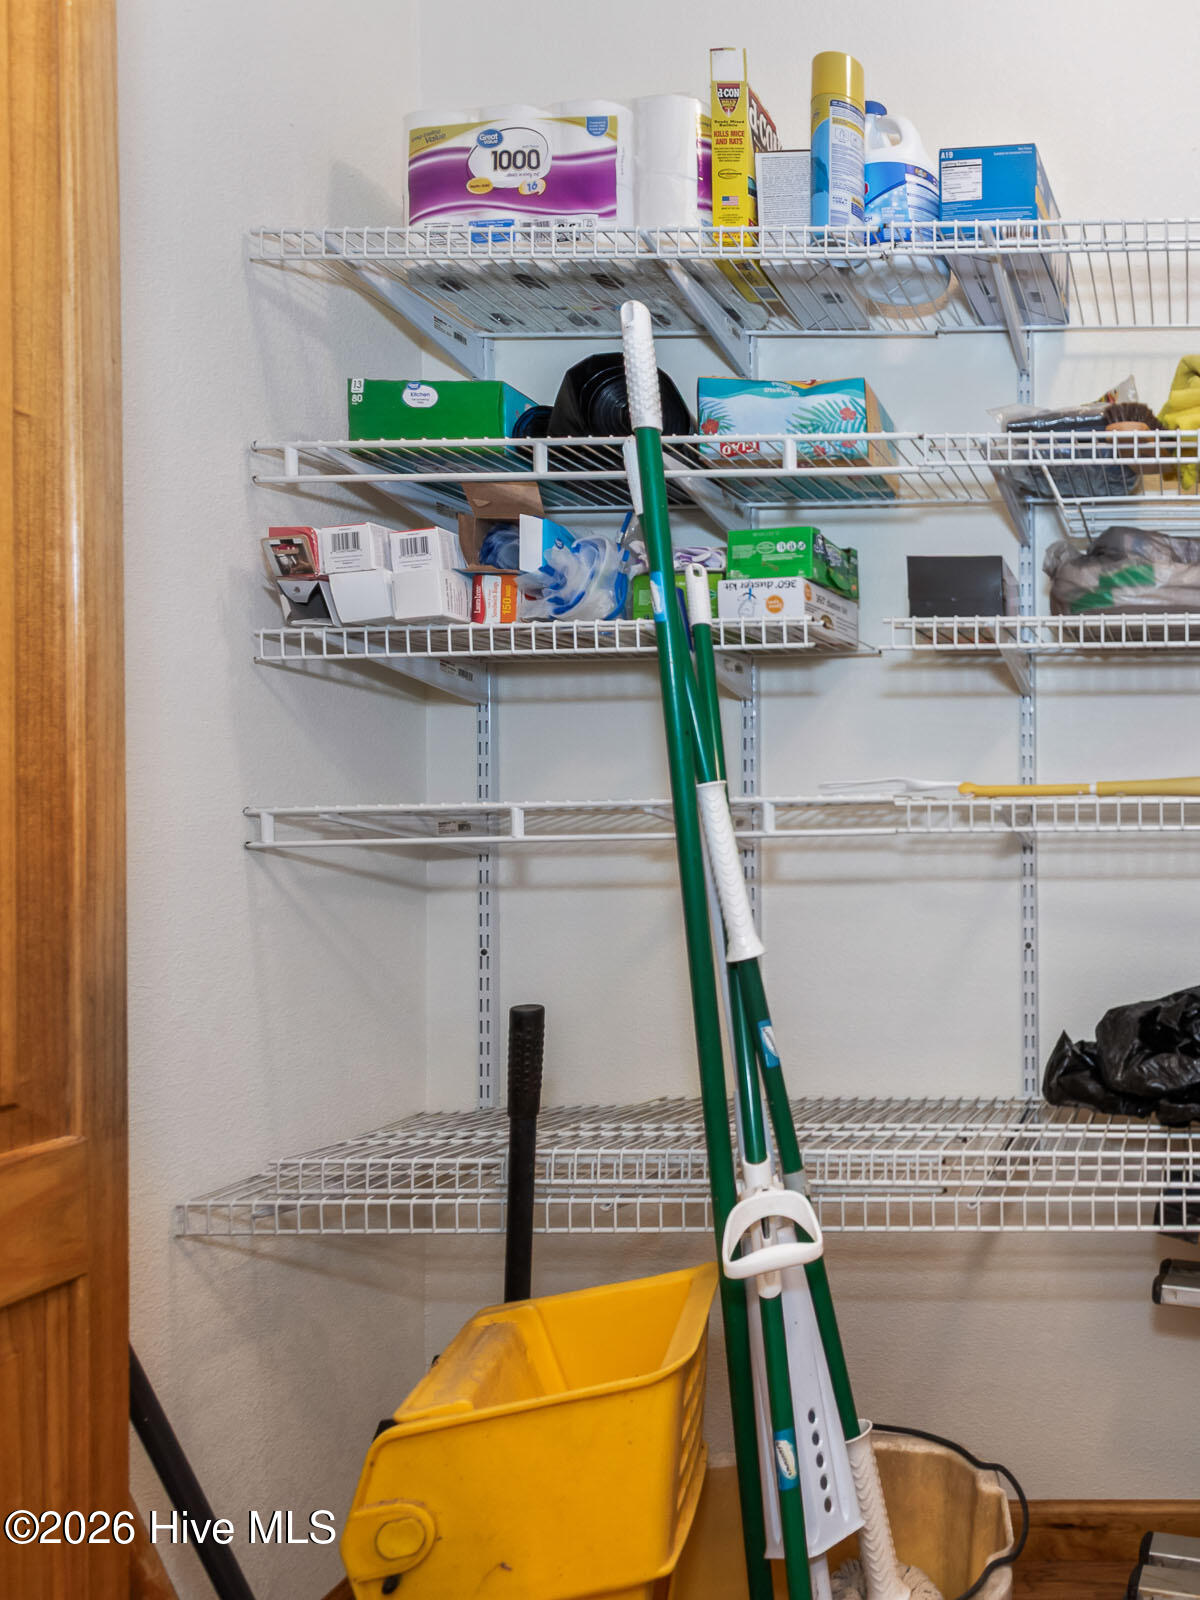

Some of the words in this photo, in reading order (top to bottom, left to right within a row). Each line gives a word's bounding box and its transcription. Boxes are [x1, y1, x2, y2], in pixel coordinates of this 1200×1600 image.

[480, 132, 498, 141] Great
[713, 130, 729, 138] KILLS
[730, 130, 745, 138] MICE
[491, 149, 541, 171] 1000
[527, 181, 538, 192] 16
[502, 598, 512, 615] 150
